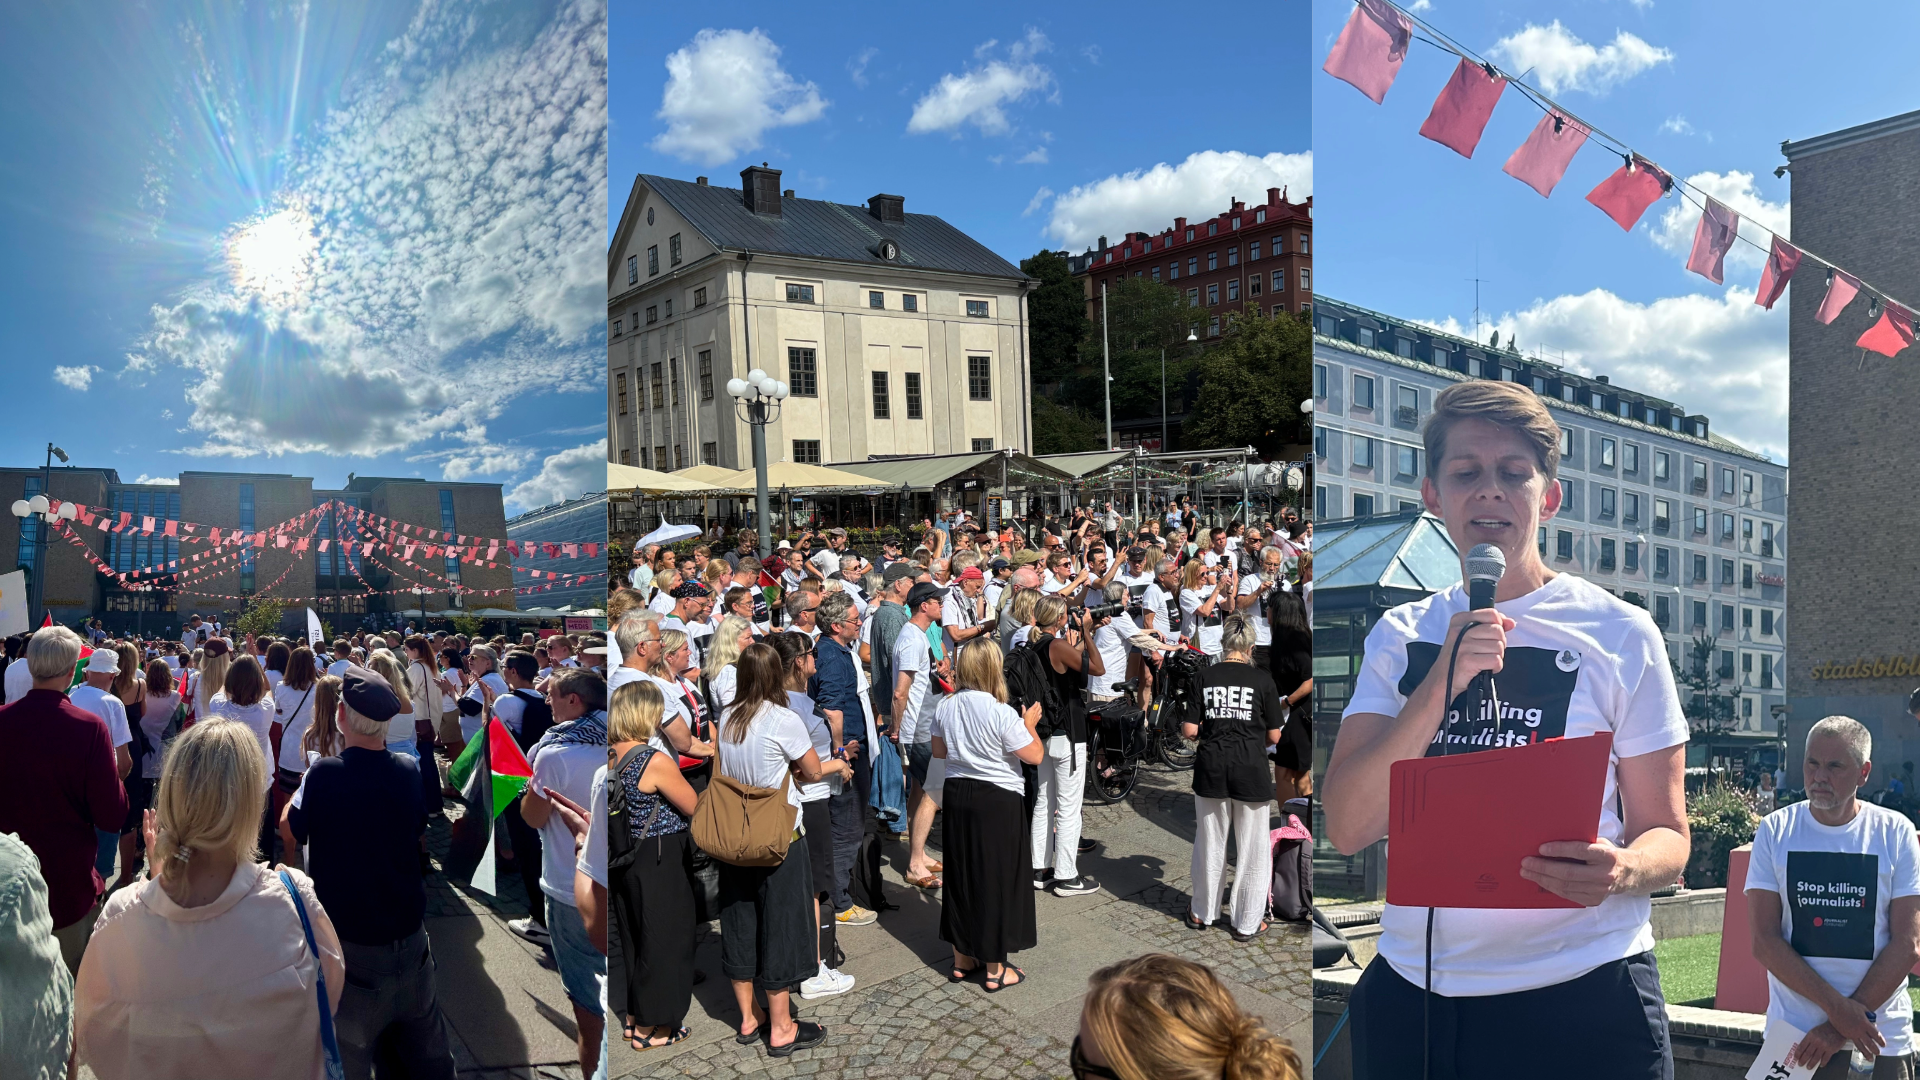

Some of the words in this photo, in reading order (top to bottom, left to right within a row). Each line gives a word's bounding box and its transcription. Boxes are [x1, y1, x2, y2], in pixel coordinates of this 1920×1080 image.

[1203, 686, 1254, 709] FREE
[1205, 707, 1252, 721] PALESTINE
[1797, 881, 1825, 895] Stop
[1828, 882, 1866, 897] killing
[1797, 894, 1865, 908] journalists!
